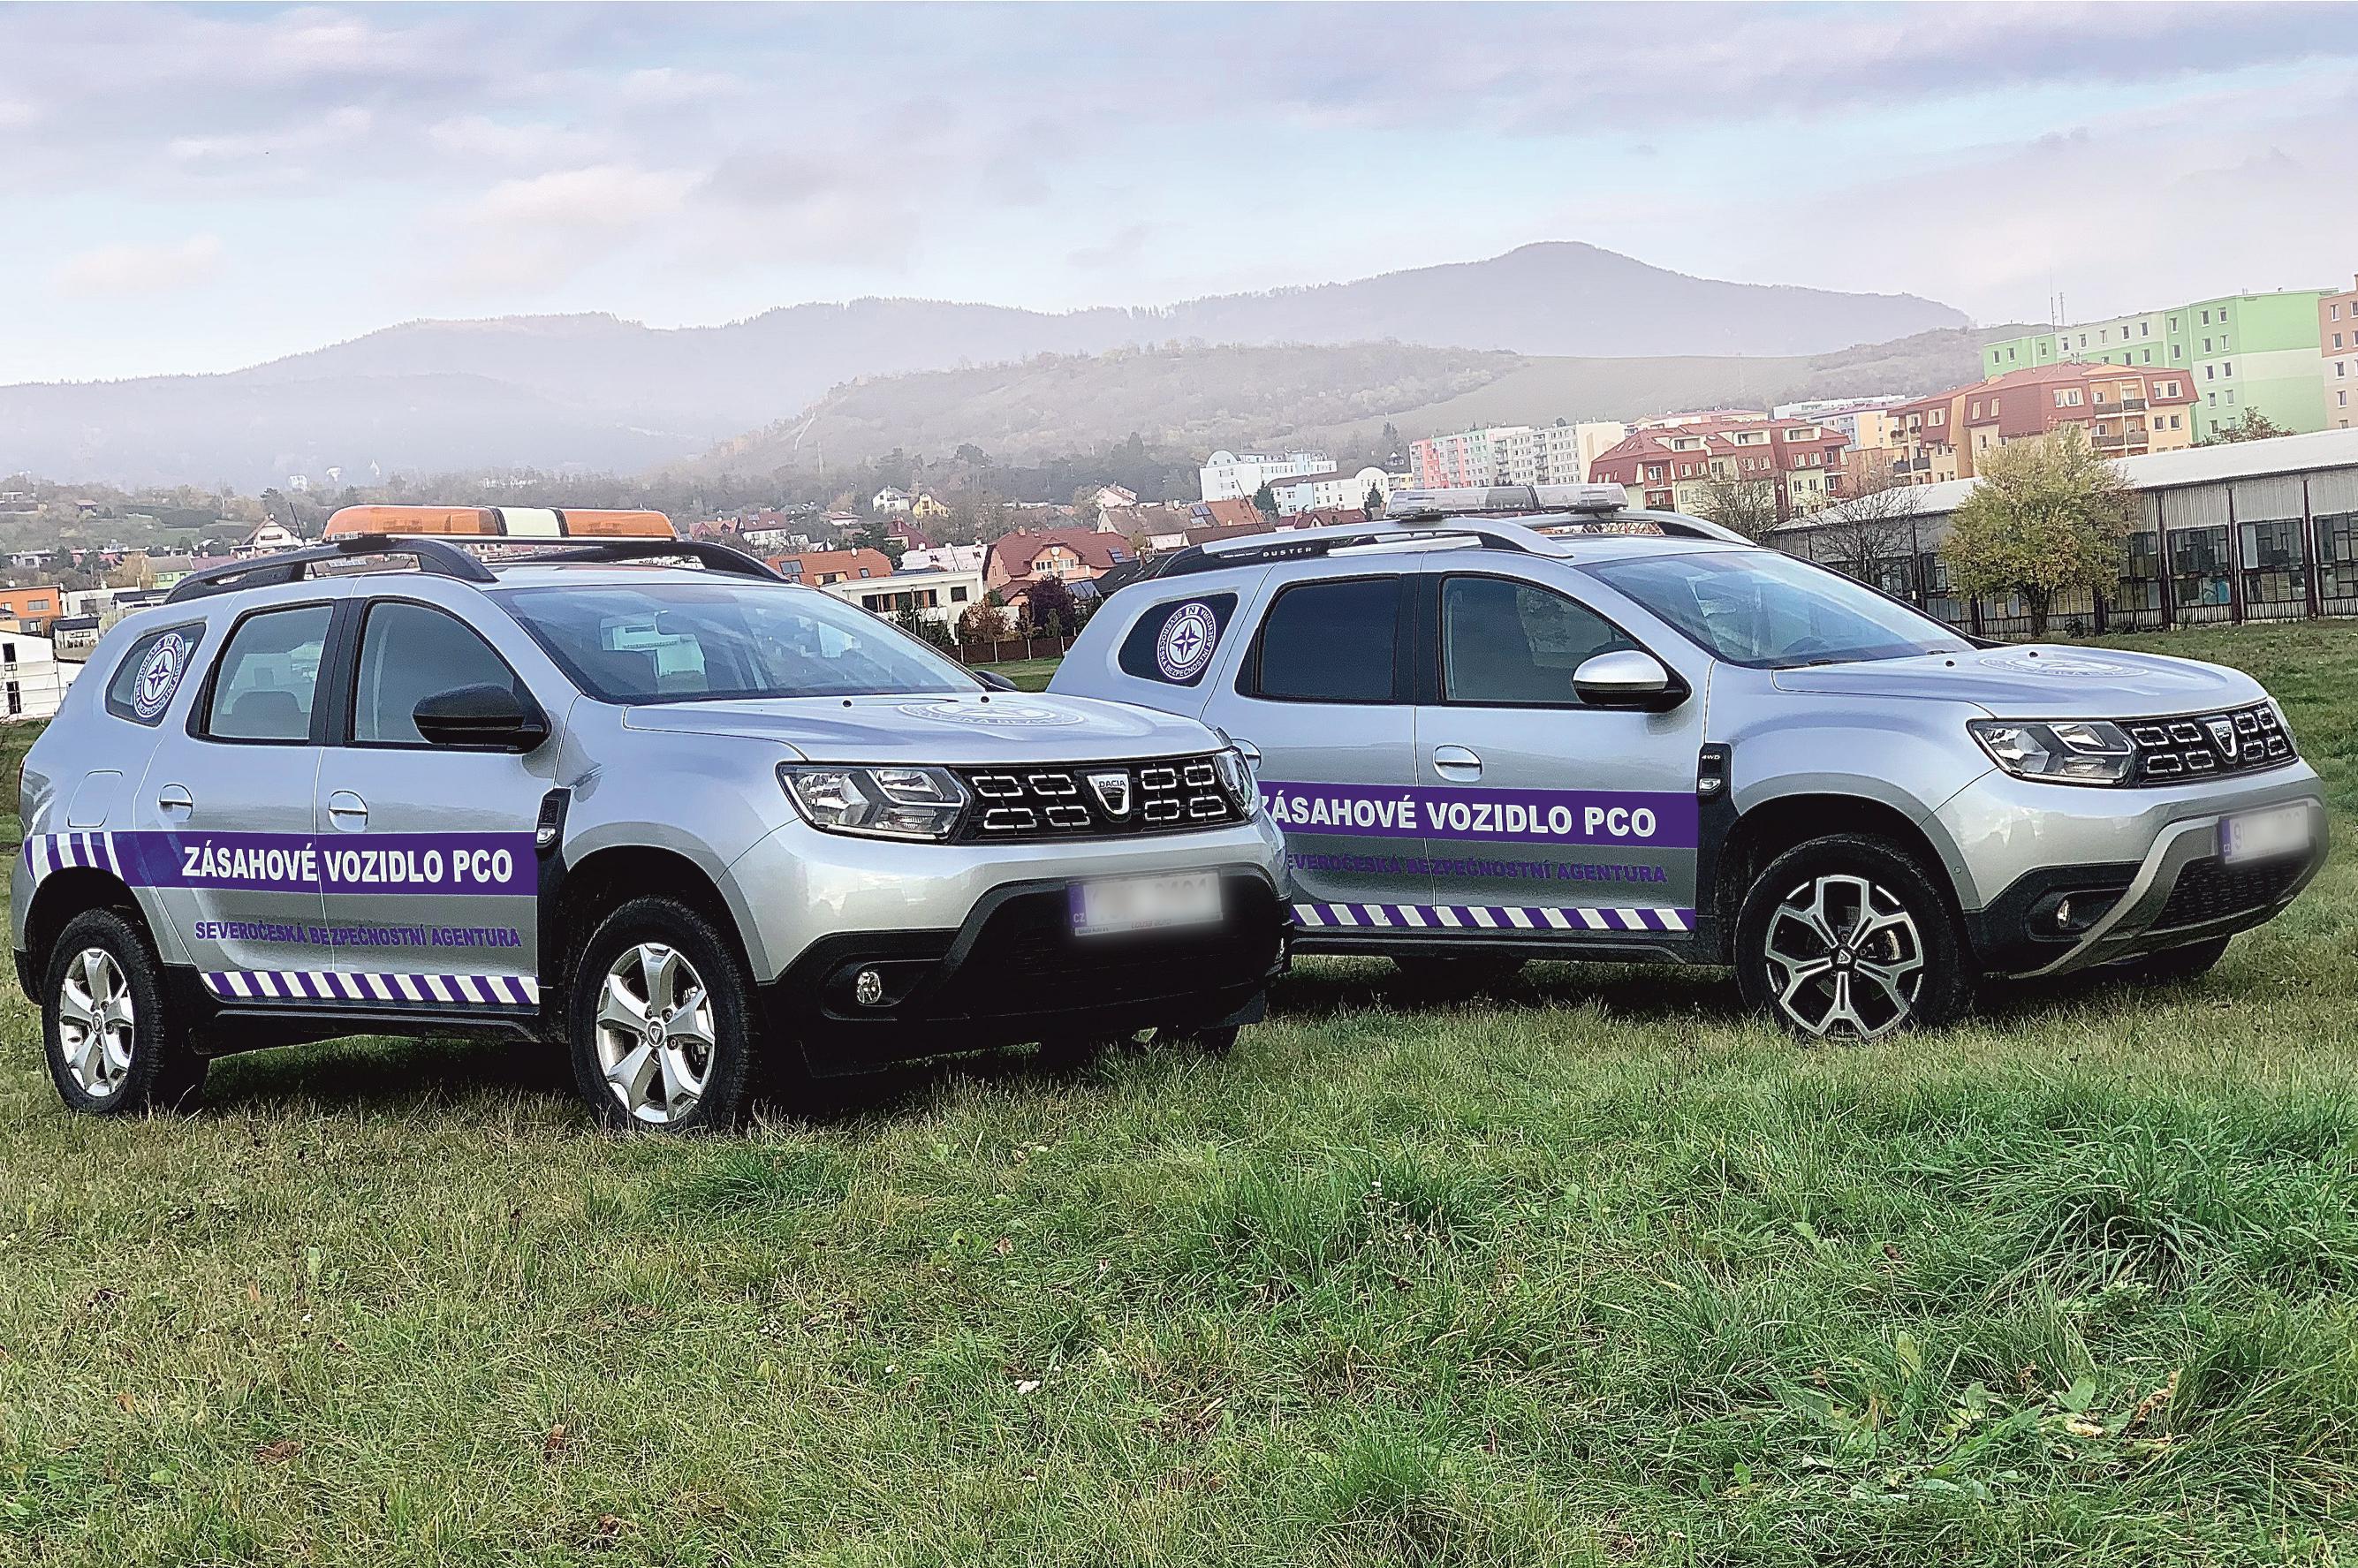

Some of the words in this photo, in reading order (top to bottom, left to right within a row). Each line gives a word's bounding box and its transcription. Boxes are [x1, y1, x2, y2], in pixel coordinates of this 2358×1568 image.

[1263, 547, 1312, 557] DUSTER
[1426, 802, 1573, 834] VOZIDLO
[1585, 807, 1657, 837] PCO
[182, 840, 318, 882] ZÁSAHOVÉ
[323, 849, 444, 882] VOZIDLO
[452, 849, 513, 882] PCO
[1406, 858, 1551, 879] BEZPEČNOSTNÍ
[1558, 863, 1668, 882] AGENTURA
[1073, 913, 1086, 923] CZ
[195, 920, 307, 943] SEVEROČESKÁ
[308, 924, 428, 947] BEZPEČNOSTNÍ
[431, 928, 522, 947] AGENTURA
